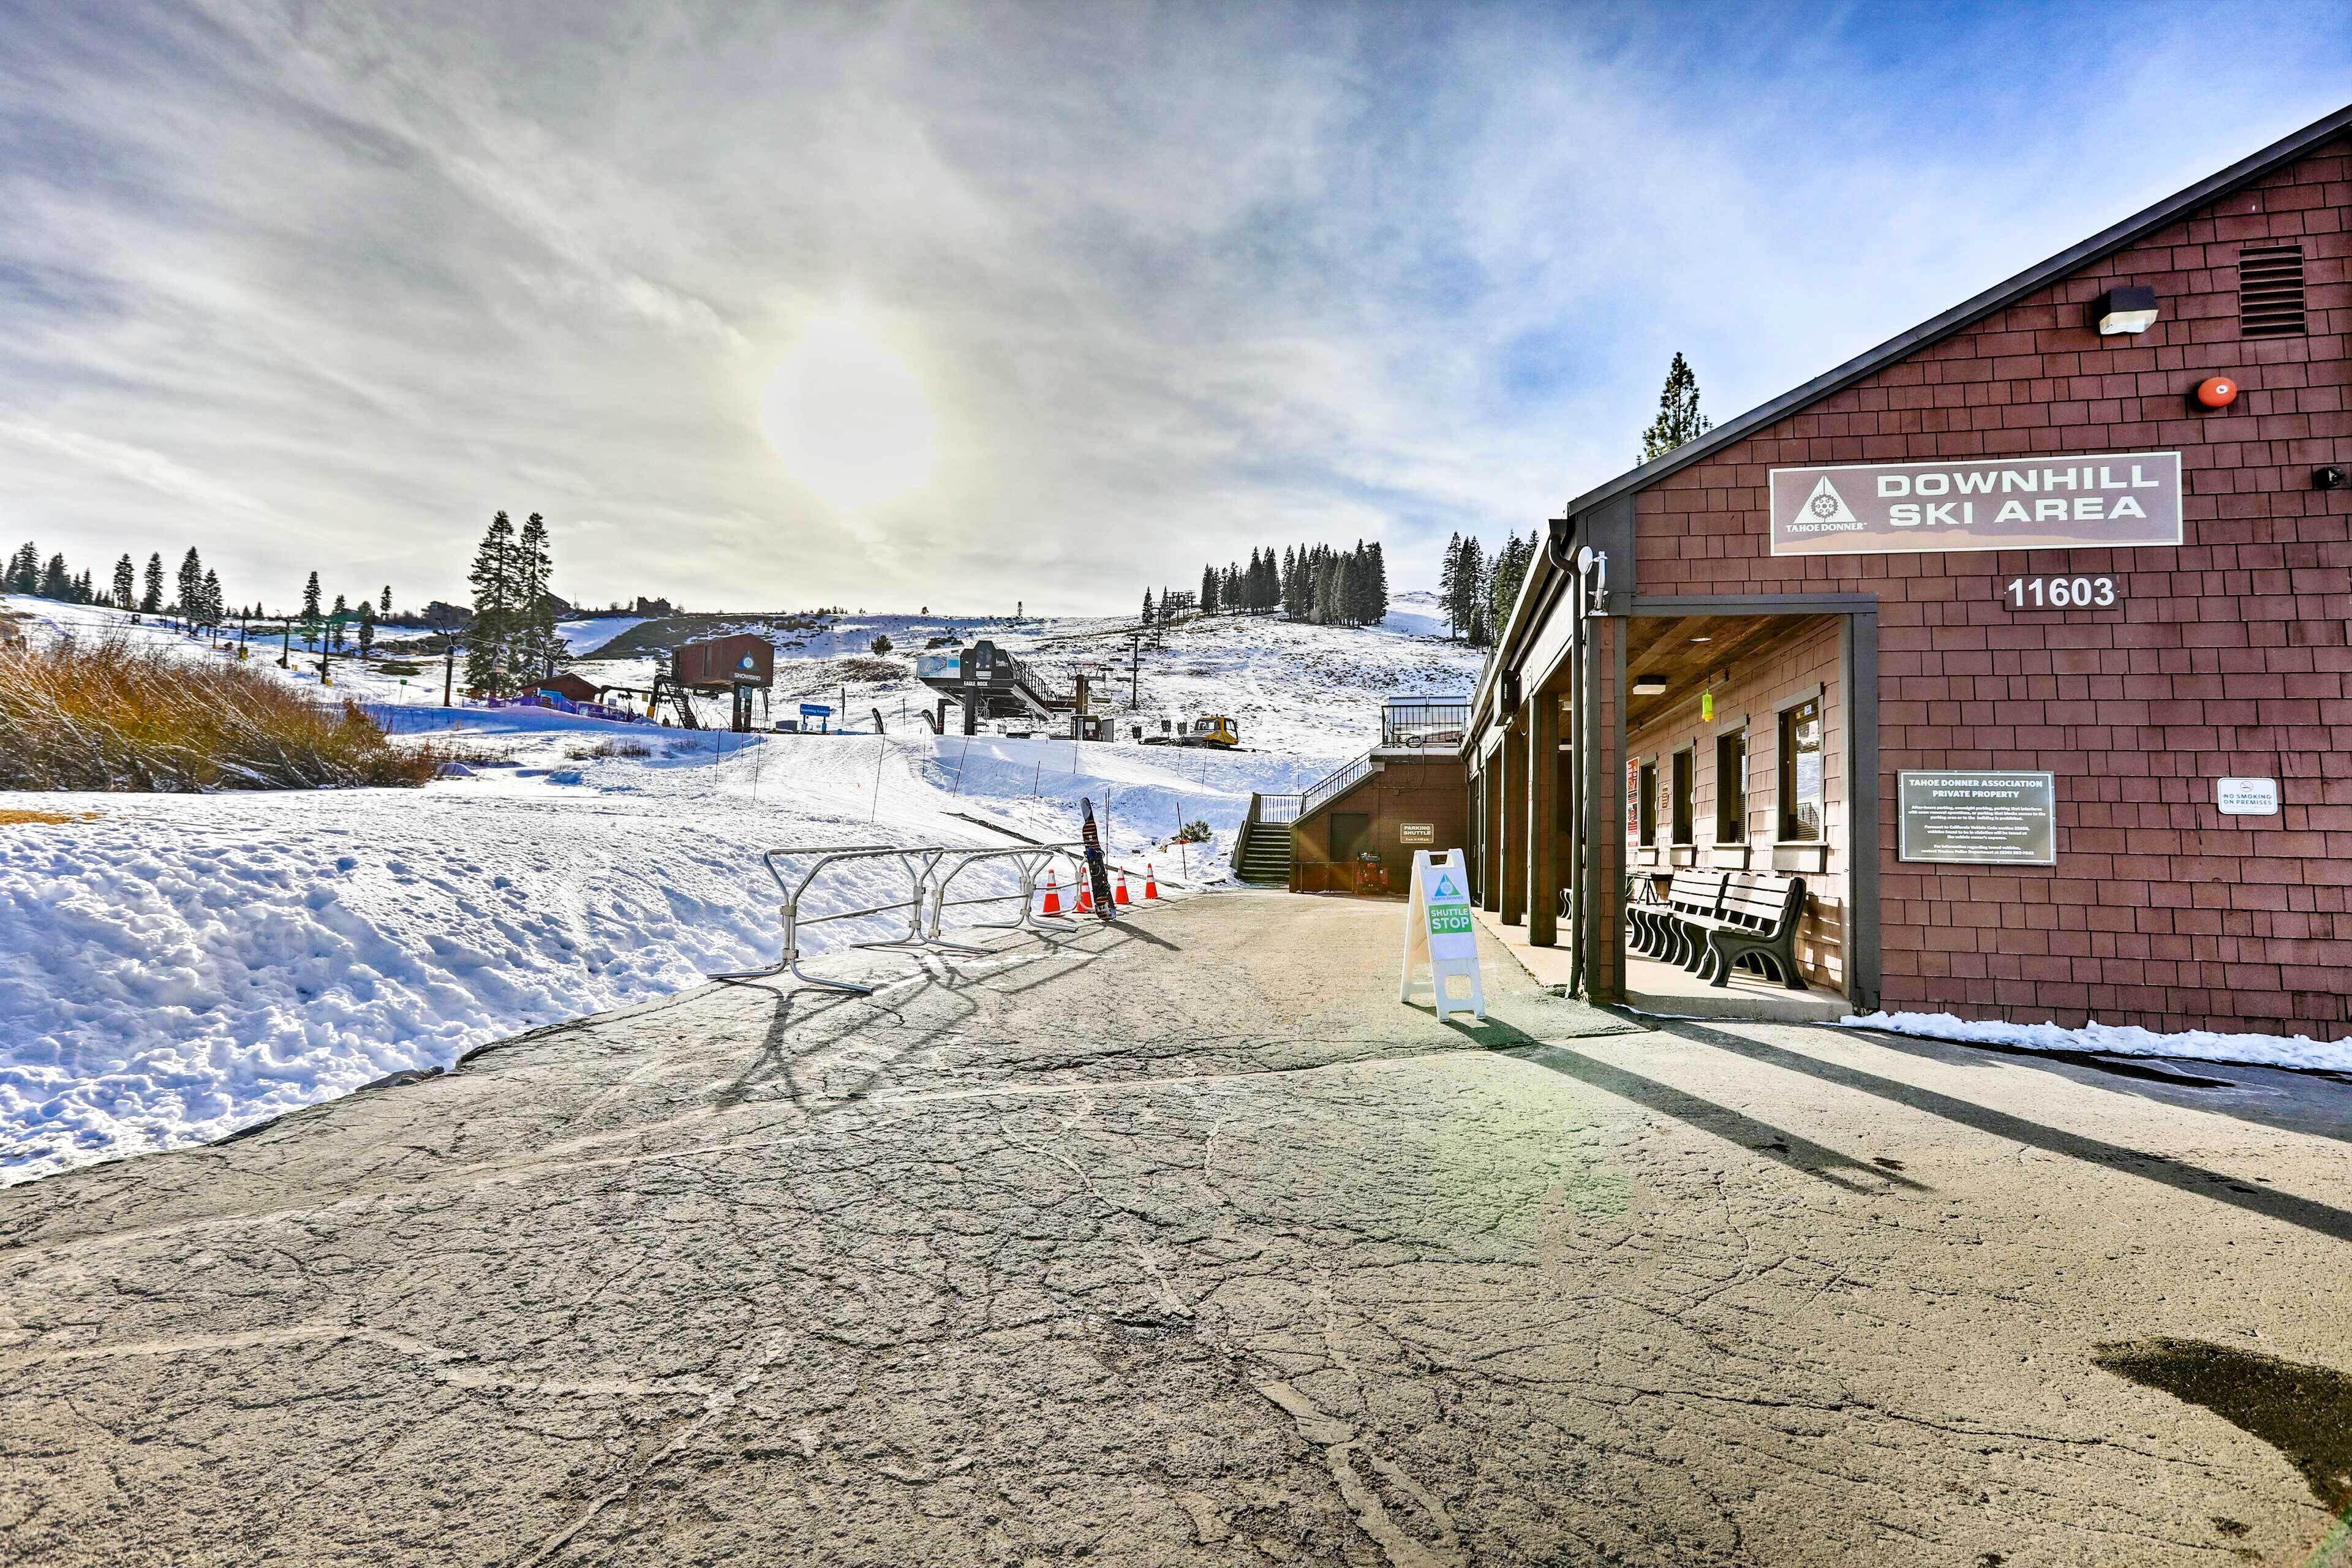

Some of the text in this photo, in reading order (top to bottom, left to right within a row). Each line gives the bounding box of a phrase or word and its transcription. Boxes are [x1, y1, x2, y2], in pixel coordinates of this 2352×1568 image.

[1877, 465, 2158, 497] DOWNHILL
[1890, 496, 2147, 526] SKI AREA
[1786, 522, 1863, 532] TAHOE DONNER
[2008, 576, 2115, 607] 11603
[1431, 908, 1468, 917] SHUTTLE
[1432, 916, 1469, 930] STOP
